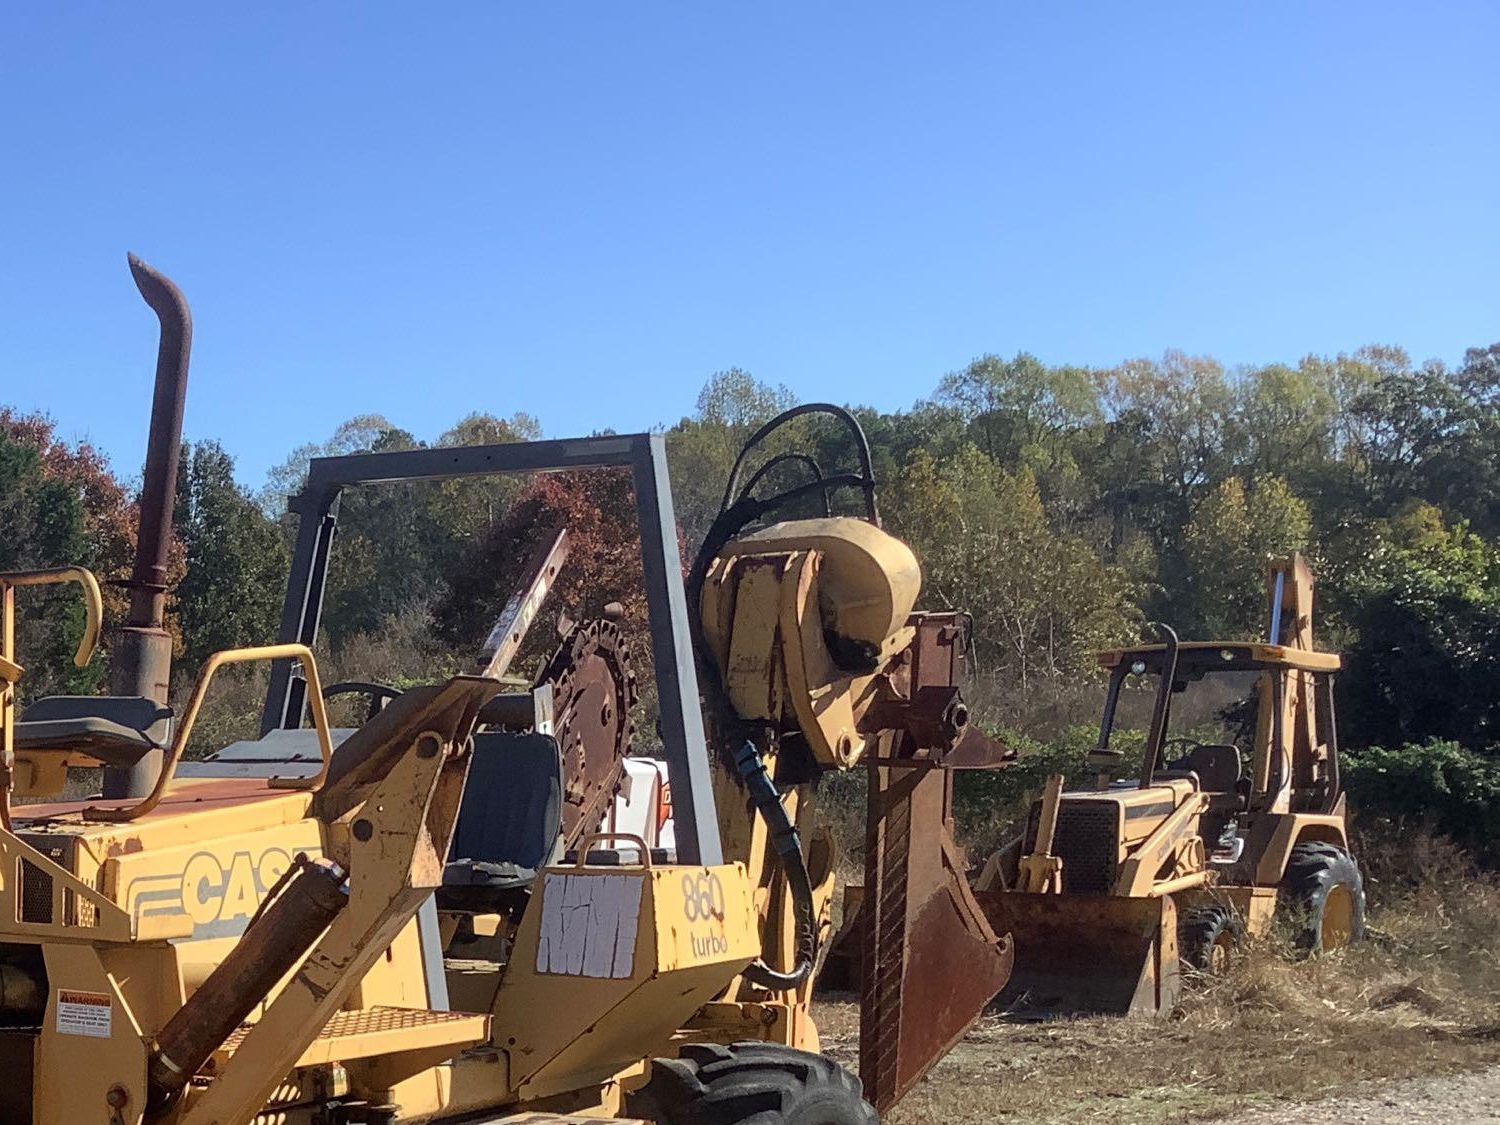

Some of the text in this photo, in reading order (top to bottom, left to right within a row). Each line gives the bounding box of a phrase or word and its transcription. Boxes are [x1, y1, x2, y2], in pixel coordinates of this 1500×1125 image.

[180, 845, 323, 925] CAS
[682, 872, 725, 922] 860
[690, 928, 728, 958] turbo
